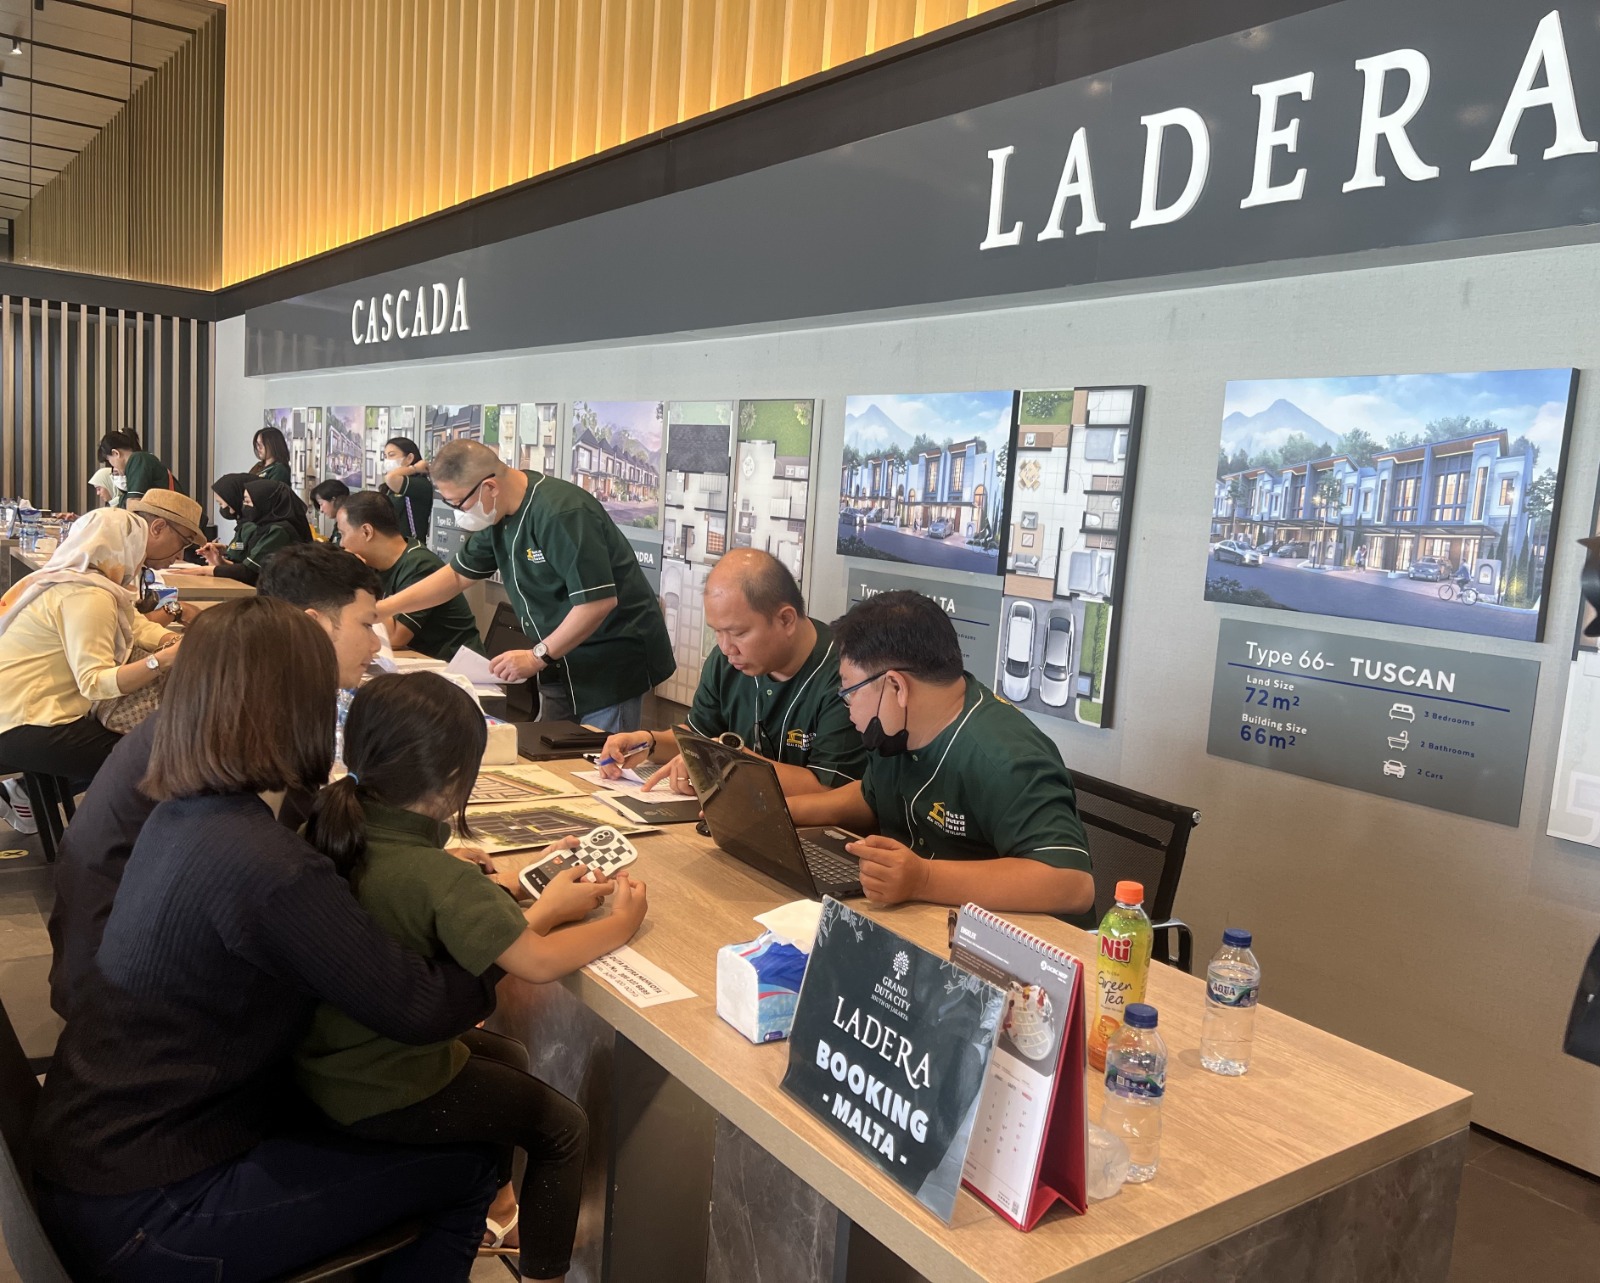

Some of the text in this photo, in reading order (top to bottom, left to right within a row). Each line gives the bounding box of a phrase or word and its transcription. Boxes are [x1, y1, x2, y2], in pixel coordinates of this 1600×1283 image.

[979, 9, 1599, 250] LADERA
[352, 277, 470, 345] CASCADA
[1246, 641, 1293, 668] Type
[1350, 657, 1456, 693] TUSCAN
[1246, 675, 1295, 691] Land Size
[1242, 713, 1308, 735] Building Size
[1432, 712, 1475, 727] Bedrooms
[1428, 742, 1475, 758] Bathrooms
[1417, 768, 1444, 780] 2 Cars
[882, 976, 908, 997] GRAND
[1098, 970, 1133, 991] Green
[1212, 982, 1236, 996] AQUA
[874, 983, 911, 1012] DUTA CITY
[832, 995, 931, 1090] LADERA
[815, 1039, 930, 1144] BOOKING
[831, 1093, 894, 1162] MALTA
